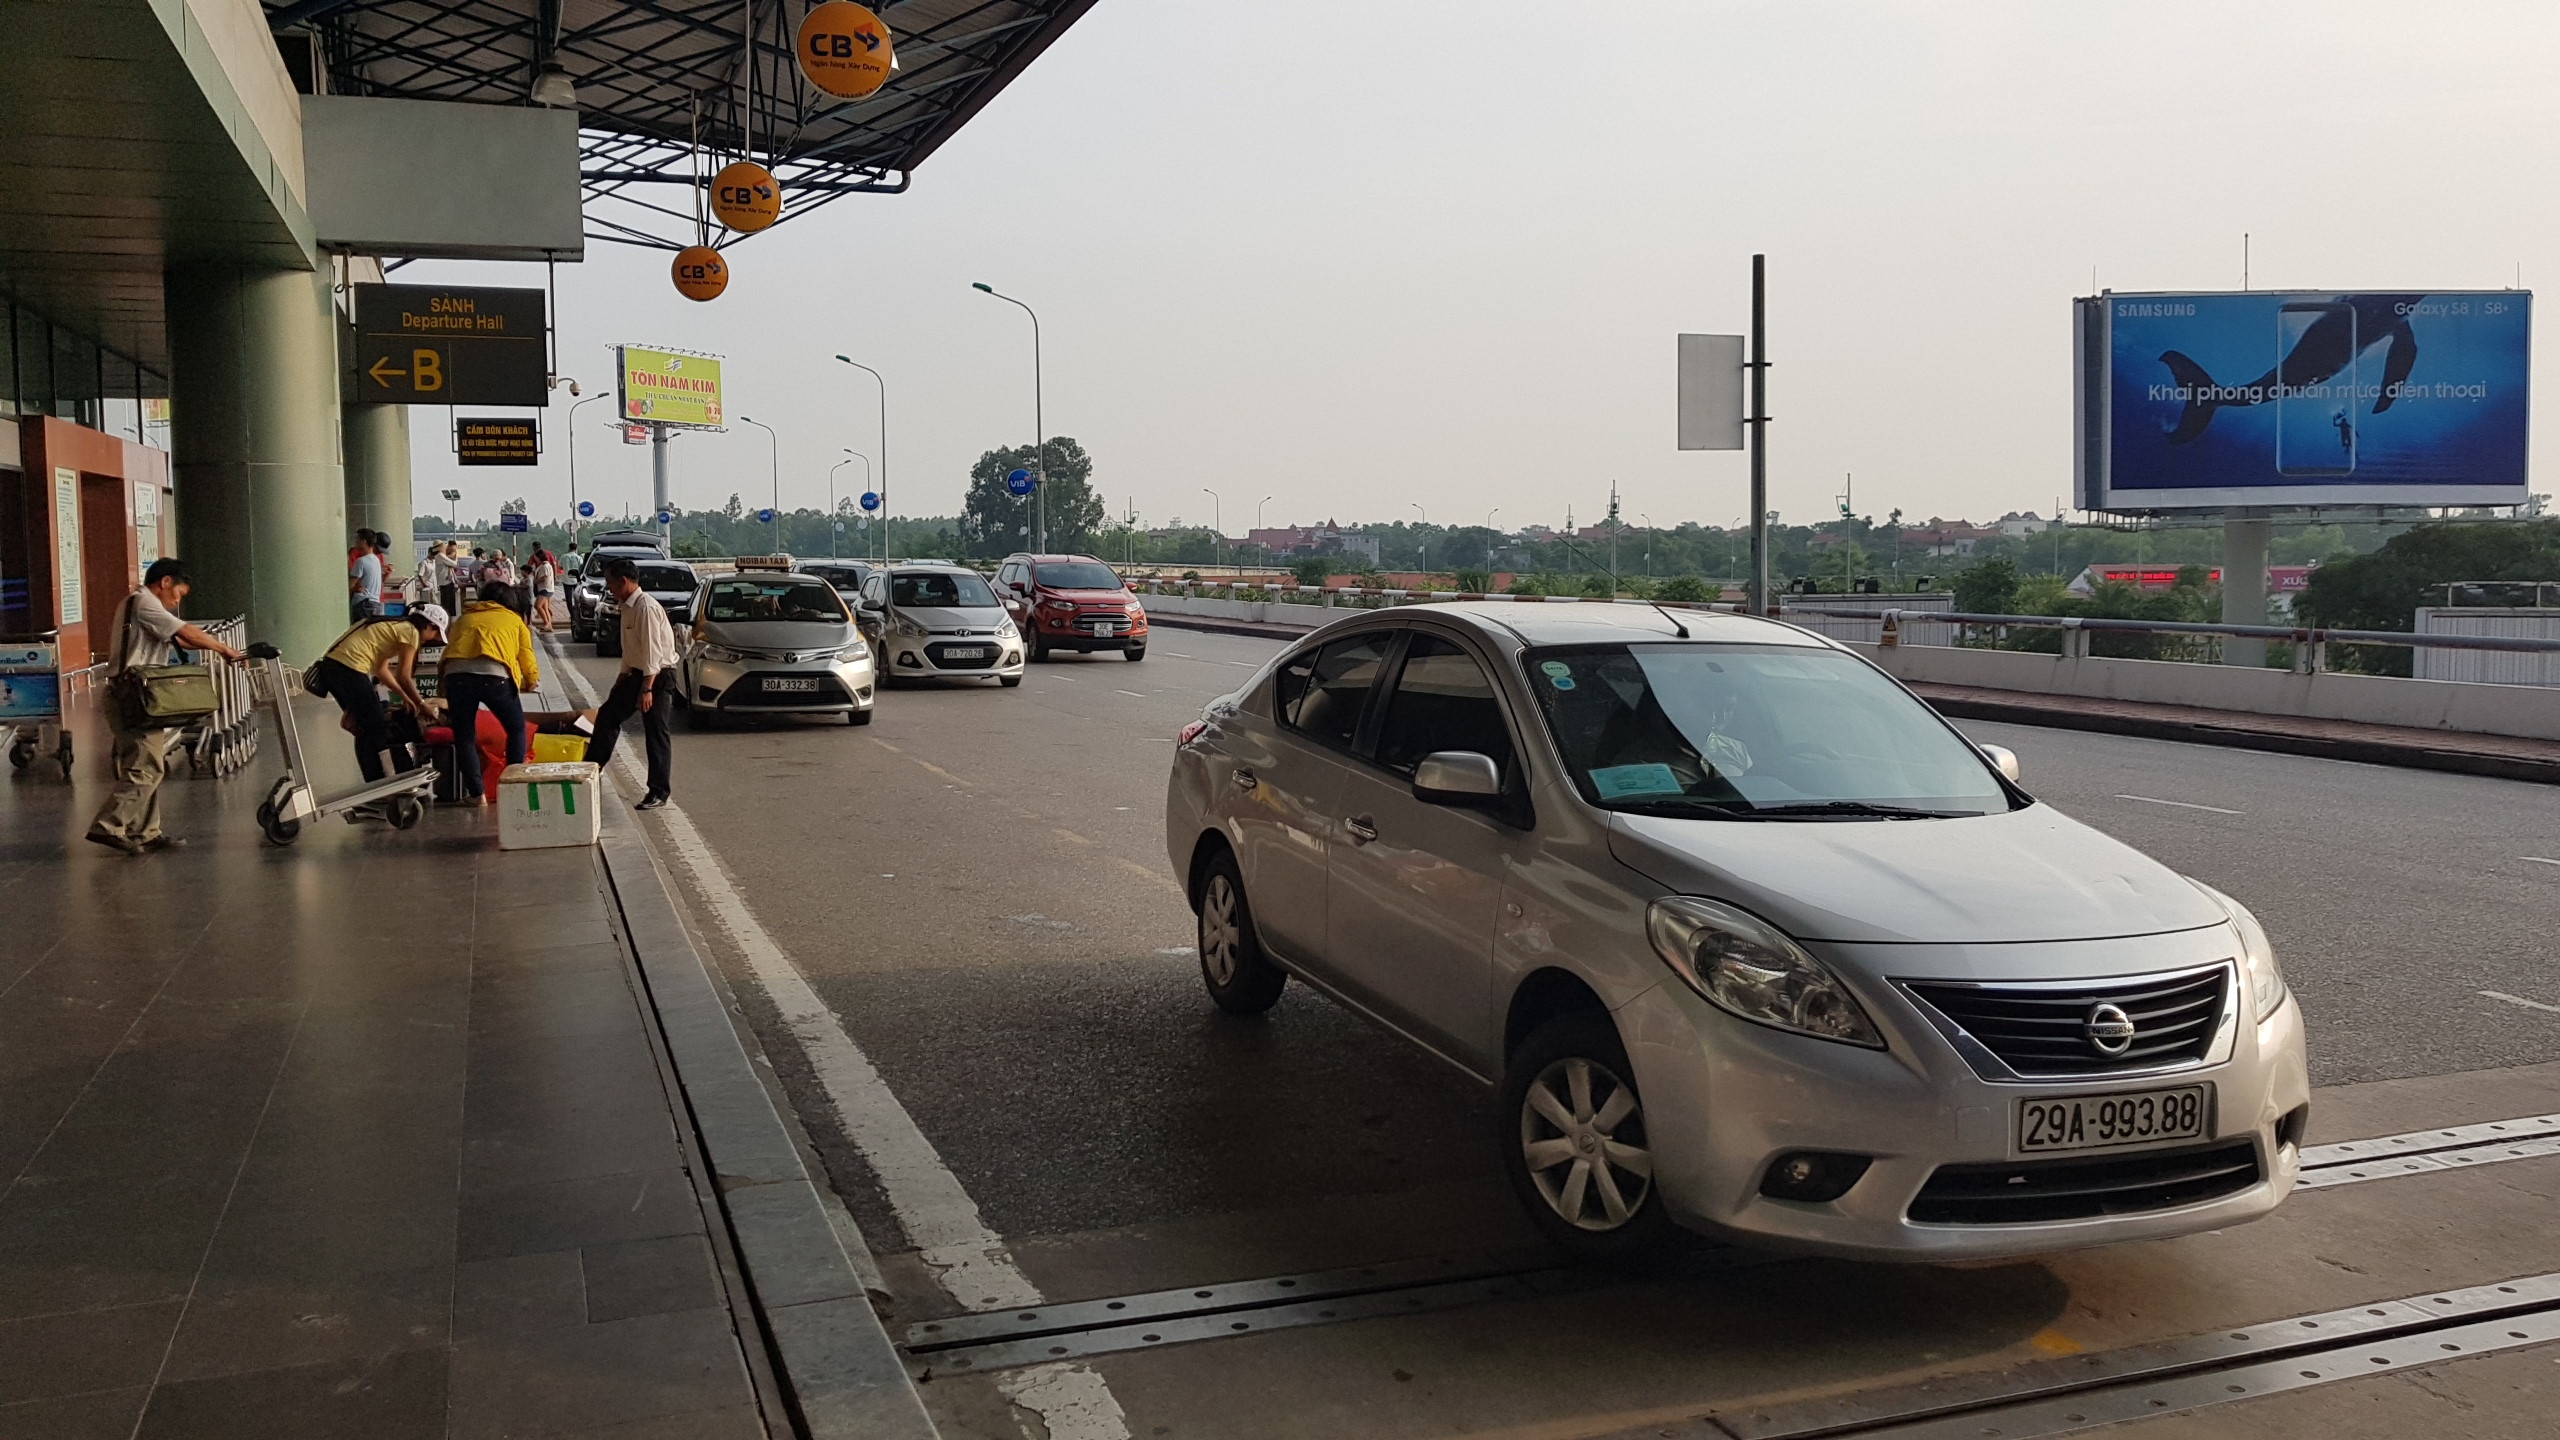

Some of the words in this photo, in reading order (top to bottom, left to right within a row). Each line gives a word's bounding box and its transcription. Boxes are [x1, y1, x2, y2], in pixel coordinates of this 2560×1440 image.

[810, 33, 853, 58] CB
[720, 186, 752, 205] CB
[680, 265, 705, 279] CB
[430, 292, 475, 313] SẢNH
[2118, 303, 2196, 317] SAMSUNG
[2393, 302, 2450, 318] Galaxy
[2451, 302, 2469, 315] S8
[2485, 302, 2509, 315] S8+
[402, 311, 473, 331] Departure
[476, 314, 504, 330] Hall
[413, 348, 443, 391] B
[630, 368, 658, 387] TÔN
[660, 374, 690, 391] NAM
[692, 378, 716, 394] KIM
[2148, 382, 2193, 401] Khai
[2196, 381, 2264, 407] phóng
[2267, 377, 2332, 399] chuẩn
[2336, 382, 2381, 403] mực
[2385, 380, 2429, 403] điện
[2435, 380, 2487, 403] thoại
[1009, 479, 1026, 488] VIB
[769, 557, 787, 565] TAXI
[2092, 1026, 2131, 1034] NISSAN
[2026, 1093, 2197, 1145] 29A-993.88
